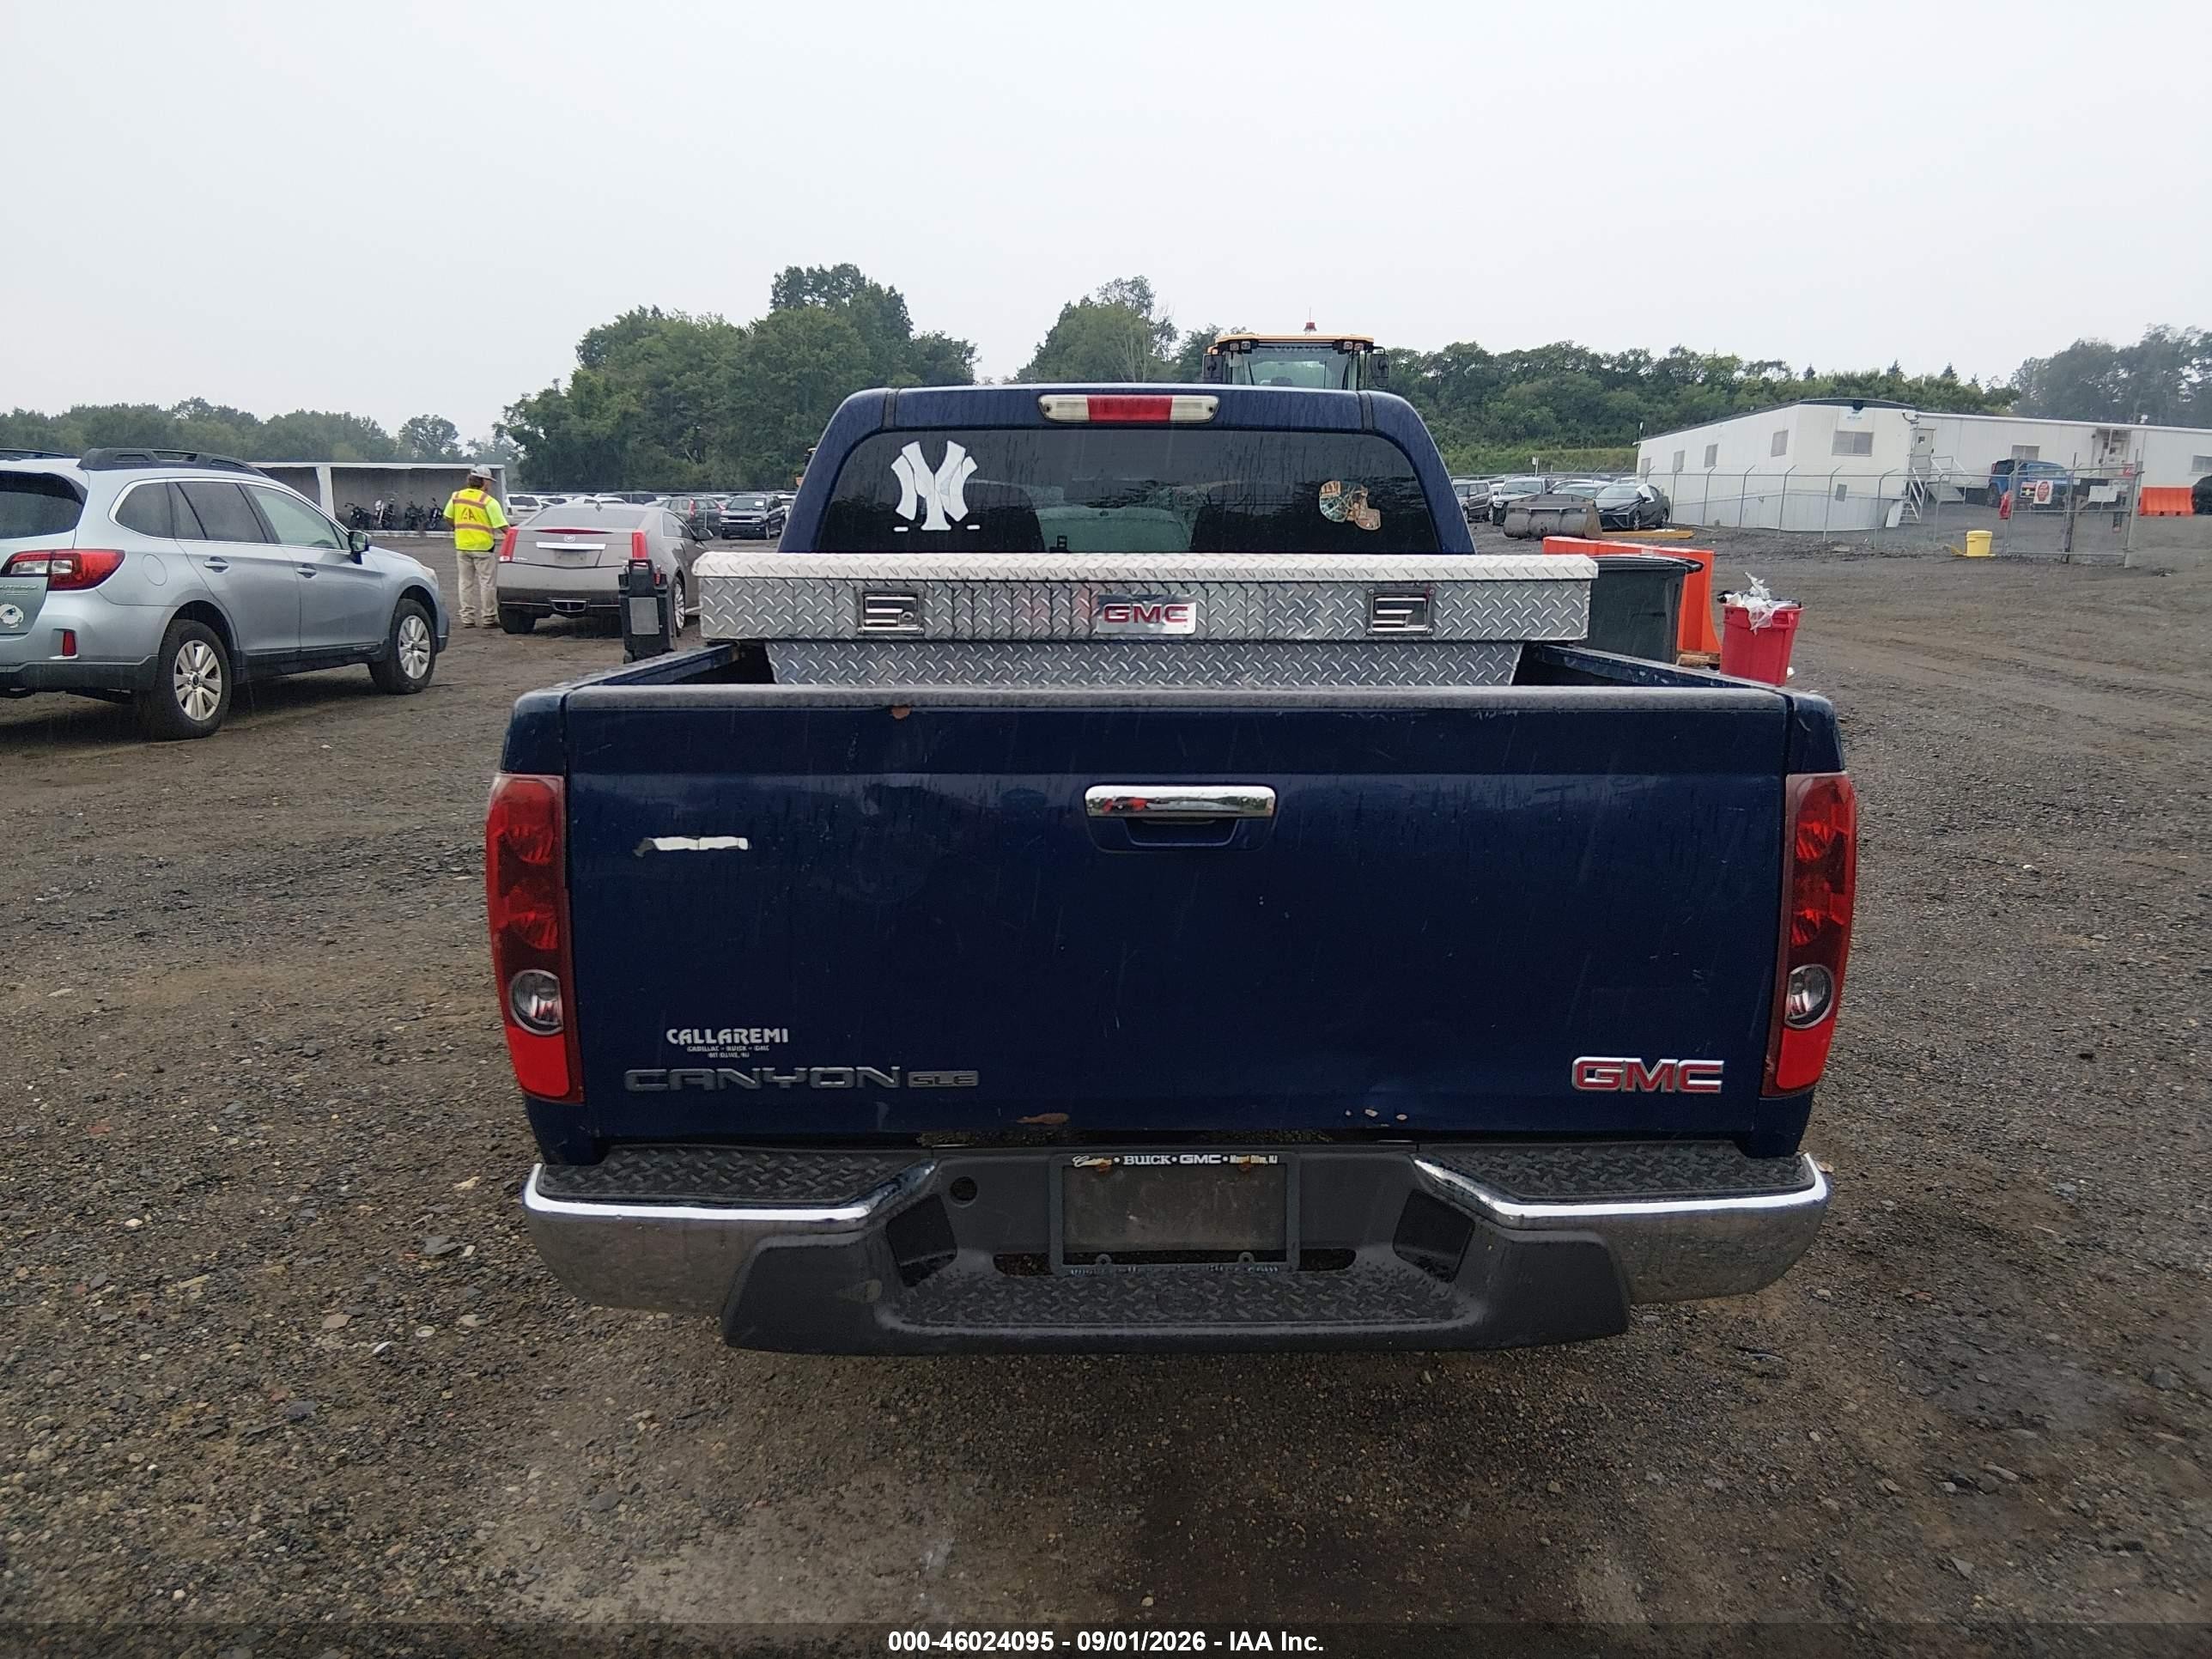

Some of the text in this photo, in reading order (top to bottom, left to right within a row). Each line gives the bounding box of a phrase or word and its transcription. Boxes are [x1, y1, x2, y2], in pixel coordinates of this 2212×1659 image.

[1104, 603, 1189, 623] GMC
[666, 1028, 789, 1045] CALLAREMI
[624, 1066, 977, 1091] CANYON SLE
[1572, 1056, 1724, 1093] GMC
[1123, 1155, 1171, 1165] BUICK
[1179, 1154, 1222, 1164] GMC
